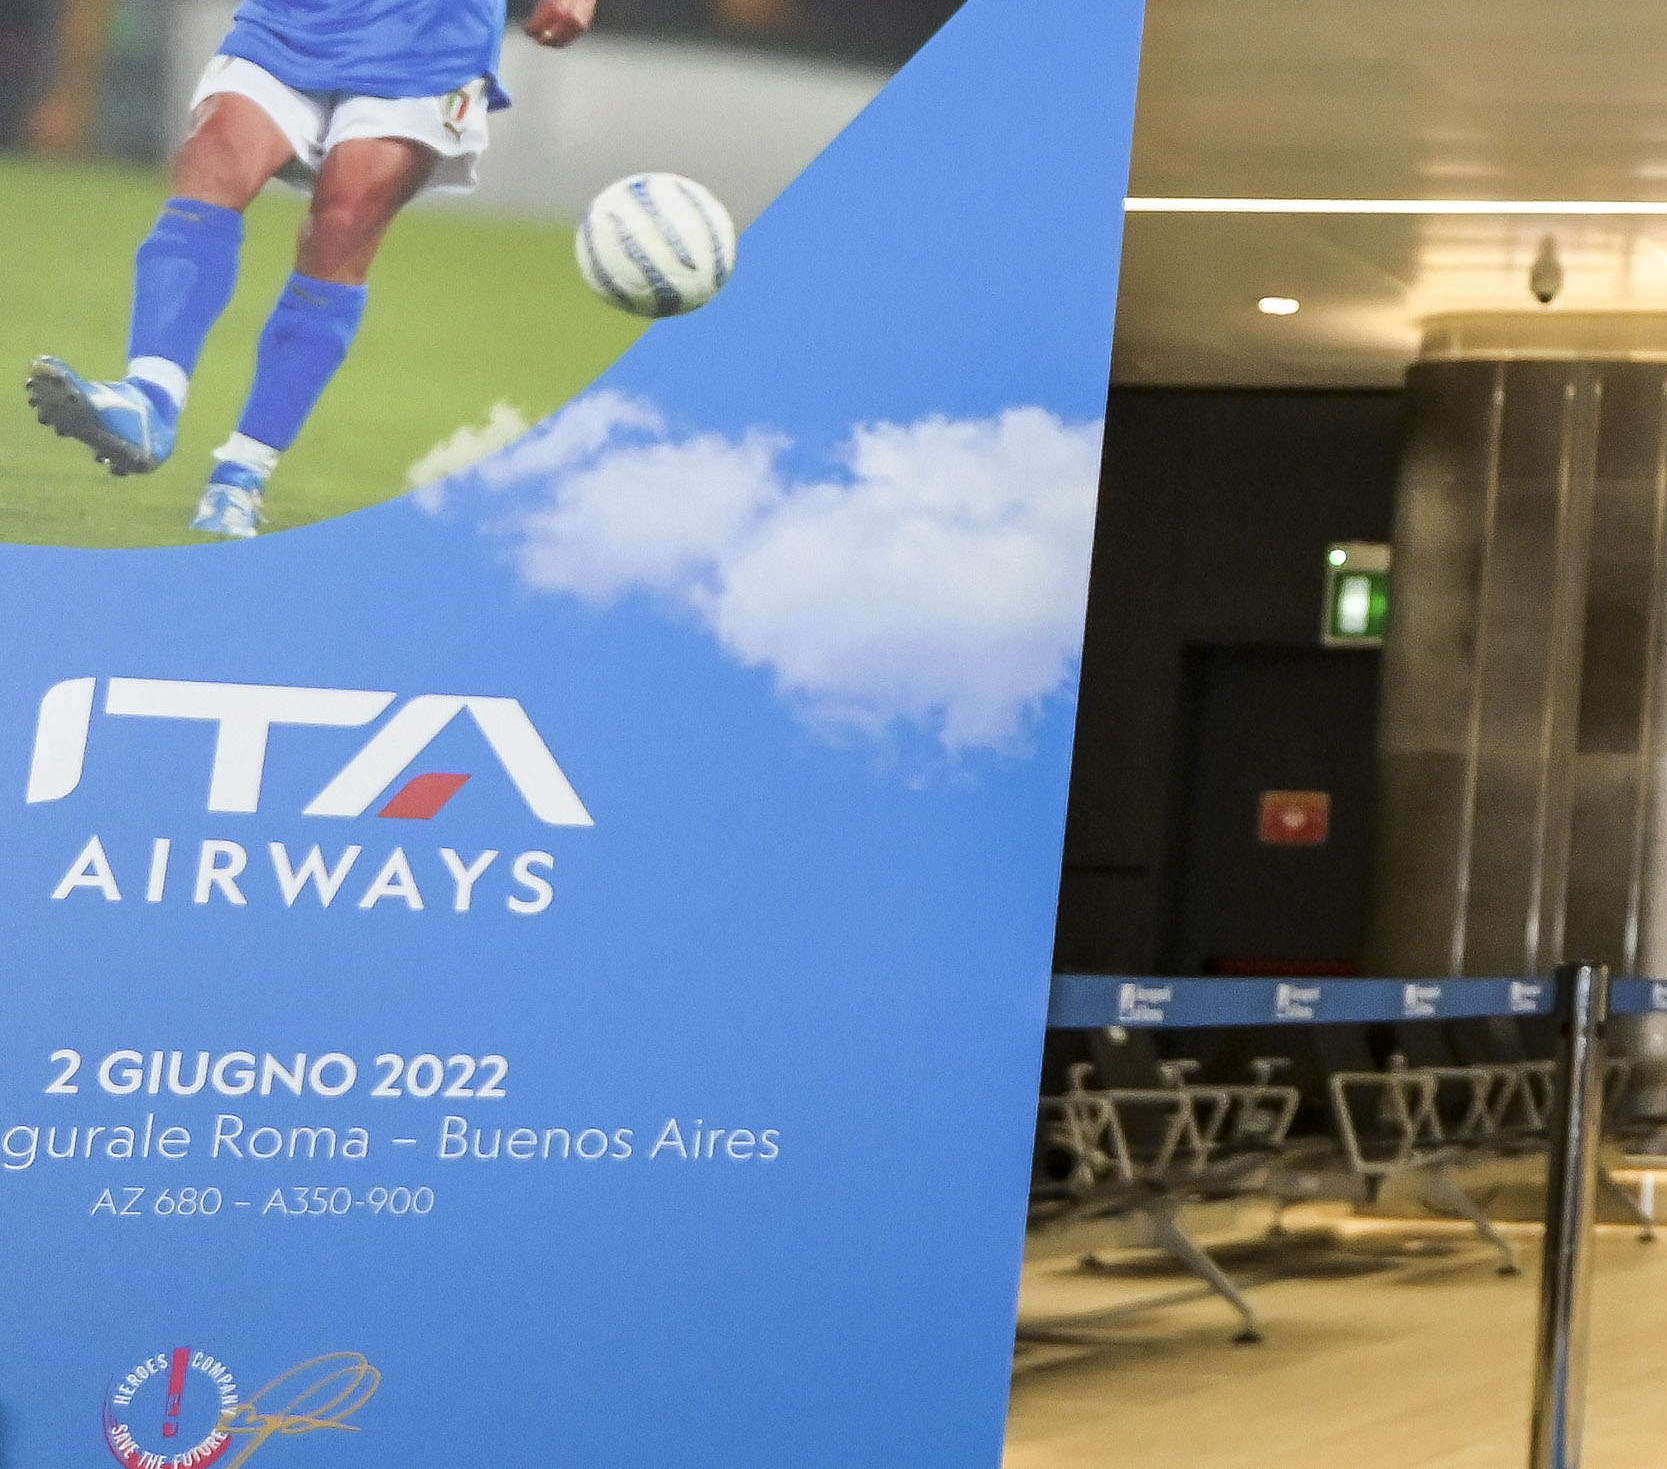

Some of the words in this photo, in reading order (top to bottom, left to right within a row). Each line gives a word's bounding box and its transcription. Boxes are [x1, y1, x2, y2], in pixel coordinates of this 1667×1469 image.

[26, 676, 595, 827] ITA
[50, 834, 556, 914] AIRWAYS
[44, 1047, 83, 1095] 2
[97, 1048, 359, 1096] GIUGNO
[370, 1052, 509, 1098] 2022
[210, 1113, 371, 1160] Roma
[437, 1114, 633, 1162] Buenos
[648, 1117, 782, 1162] Aires
[90, 1186, 144, 1217] AZ
[153, 1186, 224, 1217] 680
[261, 1185, 436, 1217] A350-900
[113, 1353, 168, 1406] HEROES
[112, 1424, 140, 1459] SAVE
[137, 1450, 168, 1469] THE
[171, 1428, 230, 1469] FUTURE
